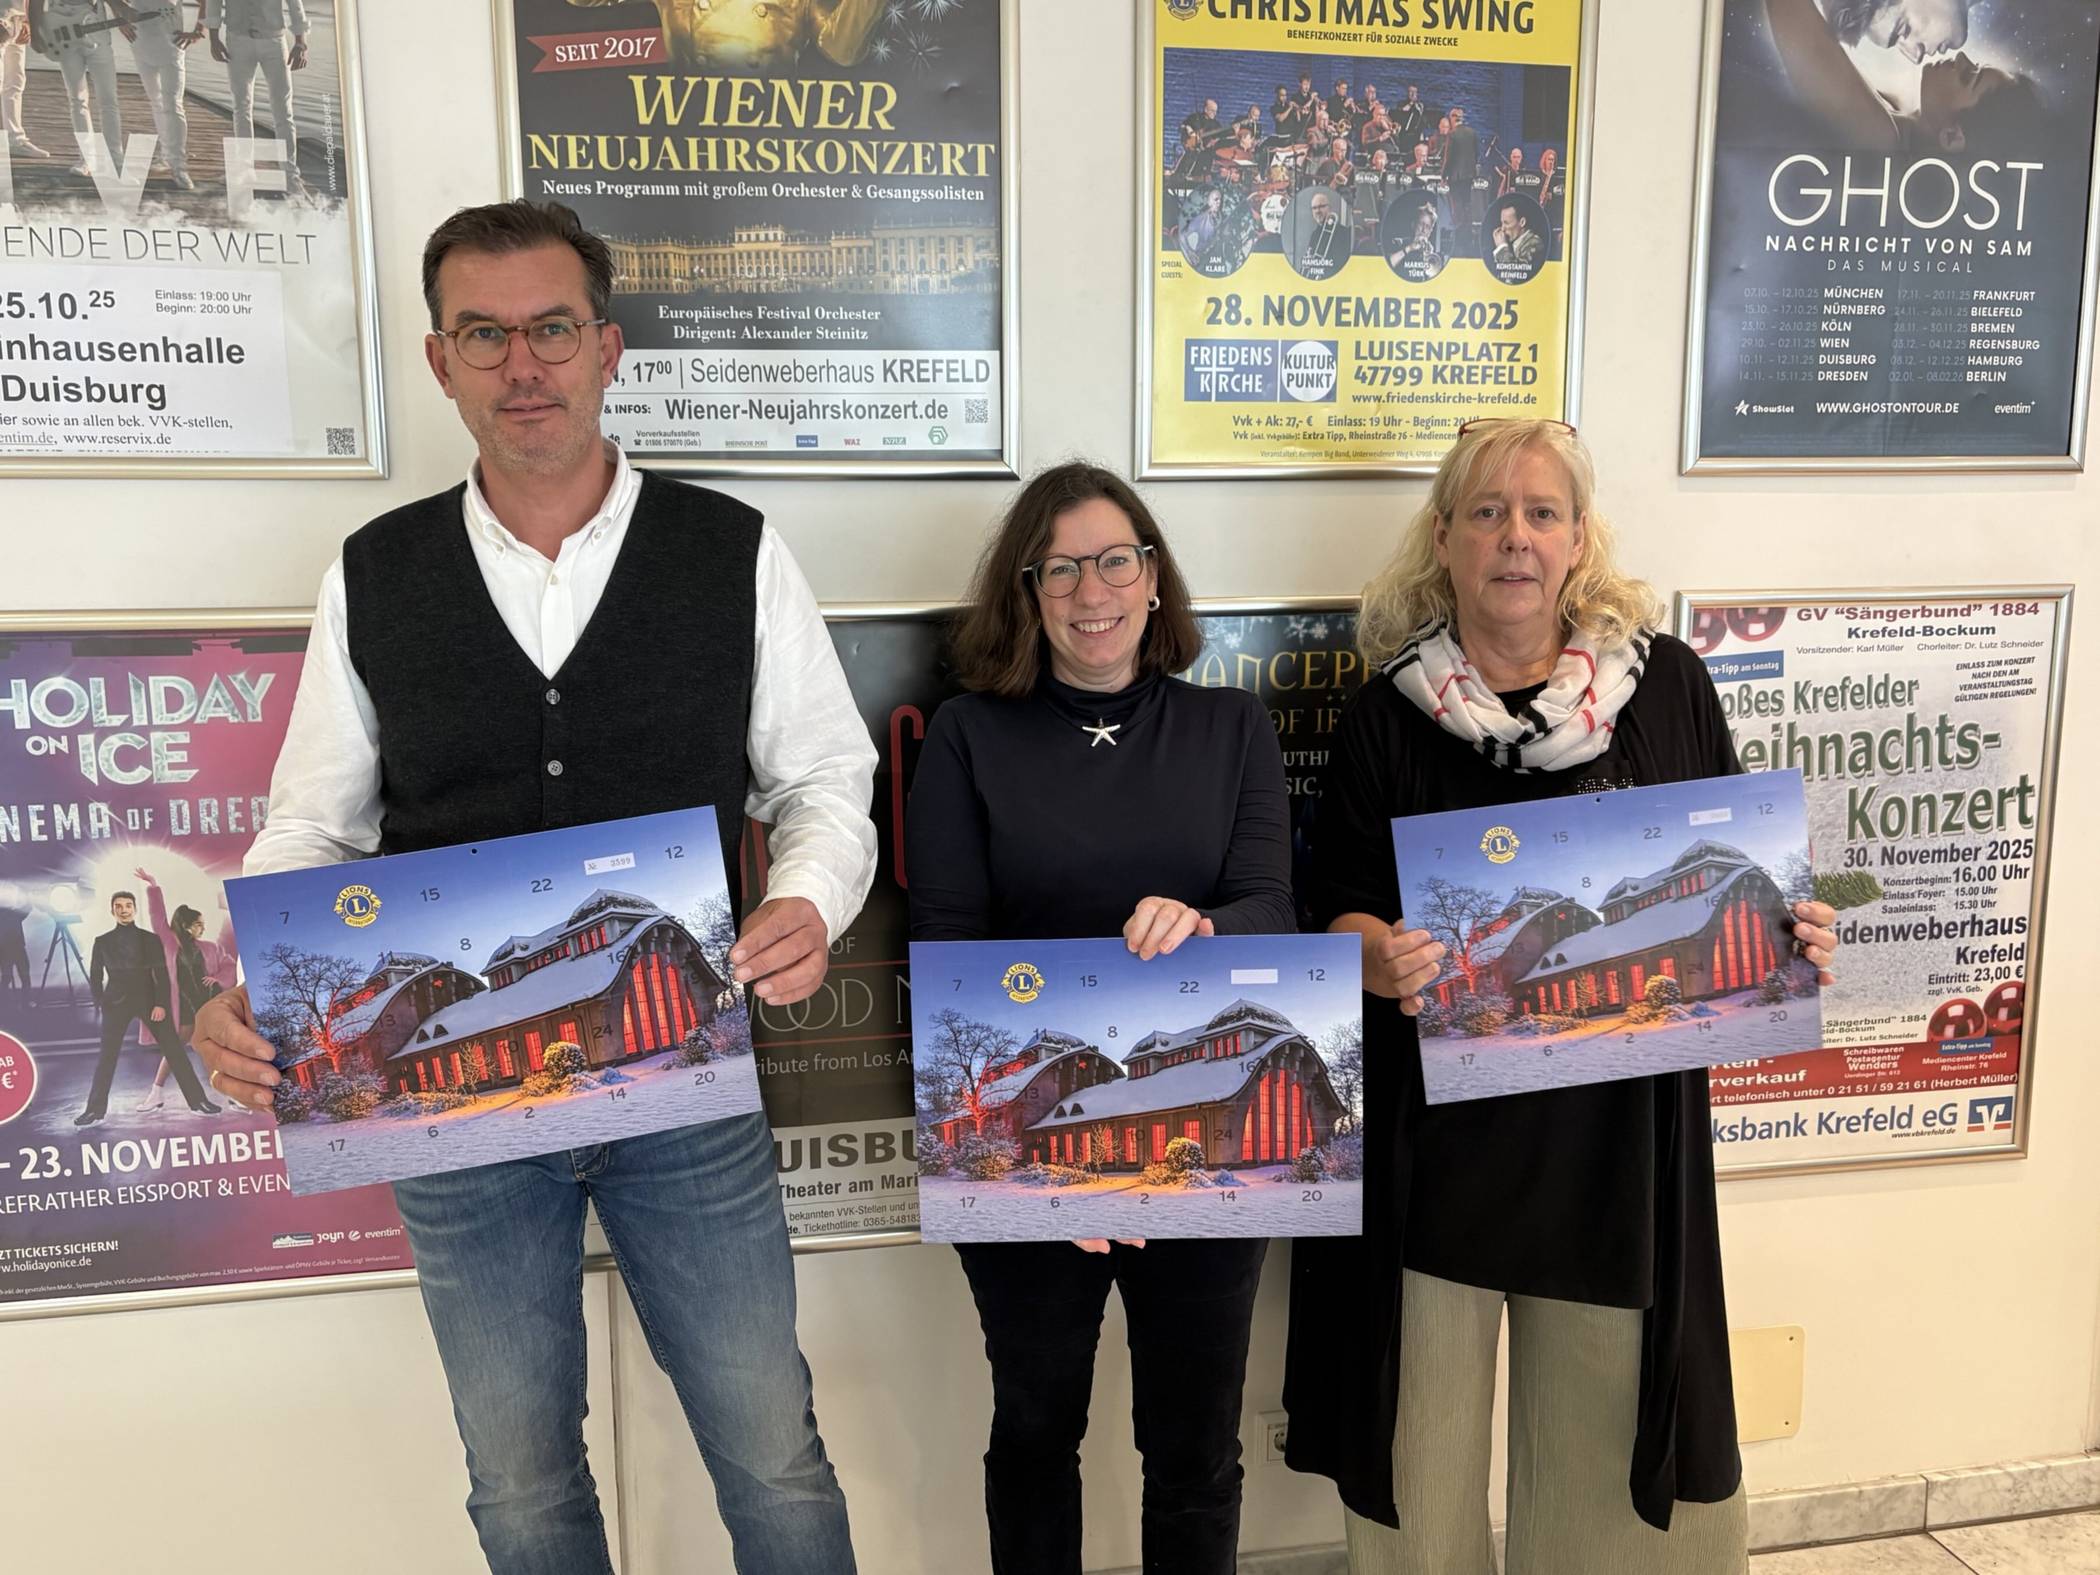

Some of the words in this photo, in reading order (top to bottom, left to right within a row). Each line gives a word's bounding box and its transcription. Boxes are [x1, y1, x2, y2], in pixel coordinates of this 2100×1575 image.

[1207, 0, 1410, 29] CHRISTMAS
[1421, 1, 1534, 34] SWING
[1287, 29, 1363, 42] BENEFIZKONZERT
[1366, 32, 1382, 43] FÜR
[1385, 34, 1421, 45] SOZIALE
[1423, 36, 1458, 47] ZWECKE
[554, 42, 599, 63] SEIT
[604, 37, 656, 59] 2017
[628, 75, 897, 130] WIENER
[527, 133, 995, 177] NEUJAHRSKONZERT
[542, 180, 592, 197] Neues
[596, 180, 680, 199] Programm
[685, 182, 708, 197] mit
[712, 182, 768, 199] großem
[771, 183, 848, 199] Orchester
[866, 184, 984, 202] Gesangssolisten
[1769, 154, 2044, 231] GHOST
[4, 225, 112, 259] ENDE
[124, 228, 201, 262] DER
[211, 231, 317, 265] WELT
[1765, 236, 1912, 253] NACHRICHT
[1925, 239, 1973, 255] VON
[1987, 240, 2032, 257] SAM
[1828, 260, 1864, 271] DAS
[1881, 261, 1973, 273] MUSICAL
[155, 290, 197, 300] Einlass:
[200, 291, 229, 301] 19:00
[232, 292, 252, 301] Uhr
[1824, 286, 1883, 298] MÜNCHEN
[1973, 290, 2035, 301] FRANKFURT
[156, 303, 196, 315] Beginn:
[200, 304, 229, 313] 20:00
[233, 306, 252, 314] Uhr
[658, 305, 753, 321] Europäisches
[757, 306, 811, 320] Festival
[814, 307, 880, 321] Orchester
[1206, 294, 1253, 326] 28.
[1263, 295, 1442, 329] NOVEMBER
[1452, 300, 1518, 330] 2025
[1823, 303, 1886, 315] NÜRNBERG
[1971, 307, 2023, 317] BIELEFELD
[673, 325, 736, 342] Dirigent:
[741, 326, 812, 340] Alexander
[816, 326, 869, 340] Steinitz
[1821, 319, 1852, 332] KÖLN
[1971, 324, 2015, 333] BREMEN
[1354, 340, 1521, 362] LUISENPLATZ
[1527, 343, 1538, 362] 1
[1820, 338, 1849, 348] WIEN
[1969, 340, 2040, 350] REGENSBURG
[1283, 353, 1335, 370] KULTUR
[1819, 355, 1877, 364] DUISBURG
[1968, 356, 2023, 365] HAMBURG
[691, 358, 875, 383] Seidenweberhaus
[882, 359, 990, 383] KREFELD
[1354, 364, 1423, 385] 47799
[1431, 364, 1538, 385] KREFELD
[1818, 371, 1868, 381] DRESDEN
[1967, 372, 2006, 382] BERLIN
[1286, 373, 1333, 389] PUNKT
[1, 374, 167, 411] Duisburg
[1352, 392, 1537, 405] www.friedenskirche-krefeld.de
[615, 405, 651, 414] INFOS:
[665, 398, 948, 423] Wiener-Neujahrskonzert.de
[1816, 402, 1959, 414] WWW.GHOSTONTOUR.DE
[1994, 403, 2032, 414] eventim
[22, 415, 60, 426] sowie
[83, 416, 114, 426] allen
[149, 416, 232, 429] VVK-stellen,
[1233, 415, 1253, 426] Vvk
[1266, 416, 1283, 426] Ak:
[1328, 416, 1366, 426] Einlass:
[1370, 417, 1380, 426] 19
[1383, 416, 1402, 426] Uhr
[1413, 416, 1450, 429] Beginn:
[64, 431, 172, 446] www.reservix.de
[1327, 432, 1346, 441] Tipp,
[1349, 432, 1396, 440] Rheinstraße
[1797, 607, 1828, 622] GV
[1989, 602, 2040, 616] 1884
[1847, 624, 1996, 639] Krefeld-Bockum
[1797, 645, 1854, 654] Vorsitzender:
[1856, 644, 1874, 652] Karl
[1876, 643, 1904, 652] Müller
[2000, 641, 2044, 649] Schneider
[1956, 662, 1985, 670] EINLASS
[2004, 657, 2035, 666] KONZERT
[1972, 671, 1991, 679] NACH
[1959, 678, 2033, 692] VERANSTALTUNGSTAG
[1794, 673, 1919, 716] Krefelder
[26, 736, 69, 755] ON
[78, 732, 199, 786] ICE
[1758, 803, 1774, 815] 12
[1847, 775, 2035, 844] Konzert
[127, 808, 152, 830] OF
[1643, 828, 1662, 840] 22
[664, 846, 684, 860] 12
[1844, 847, 1873, 868] 30.
[1881, 843, 1981, 866] November
[1987, 839, 2033, 860] 2025
[1952, 866, 1997, 883] 16.00
[2003, 865, 2030, 880] Uhr
[530, 878, 553, 893] 22
[1883, 877, 1951, 887] Konzertbeginn:
[419, 888, 440, 902] 15
[1955, 887, 1979, 896] 15.00
[1982, 885, 1997, 895] Uhr
[460, 938, 472, 951] 8
[1955, 943, 2025, 965] Krefeld
[1079, 975, 1097, 988] 15
[1307, 969, 1325, 981] 12
[1928, 974, 1970, 985] Eintritt:
[1974, 966, 2011, 983] 23,00
[1179, 981, 1200, 994] 22
[1769, 1010, 1787, 1023] 20
[1107, 1026, 1118, 1038] 8
[814, 1054, 857, 1070] from
[864, 1051, 892, 1067] Los
[1848, 1062, 1898, 1071] Wenders
[694, 1070, 716, 1086] 20
[1930, 1078, 1978, 1089] (Herbert
[1980, 1073, 2017, 1085] Müller)
[1725, 1091, 1790, 1103] telefonisch
[1793, 1087, 1825, 1097] unter
[1817, 1105, 1913, 1137] Krefeld
[1922, 1104, 1958, 1126] eG
[19, 1147, 72, 1179] 23.
[118, 1179, 213, 1205] EISSPORT
[849, 1180, 873, 1193] am
[960, 1197, 976, 1208] 17
[1219, 1191, 1236, 1203] 14
[1302, 1190, 1322, 1203] 20
[790, 1210, 834, 1221] bekannten
[837, 1204, 887, 1216] VVK-Stellen
[365, 1228, 400, 1238] eventim
[804, 1220, 859, 1232] Tickethotline:
[14, 1245, 61, 1259] TICKETS
[64, 1241, 118, 1255] SICHERN!
